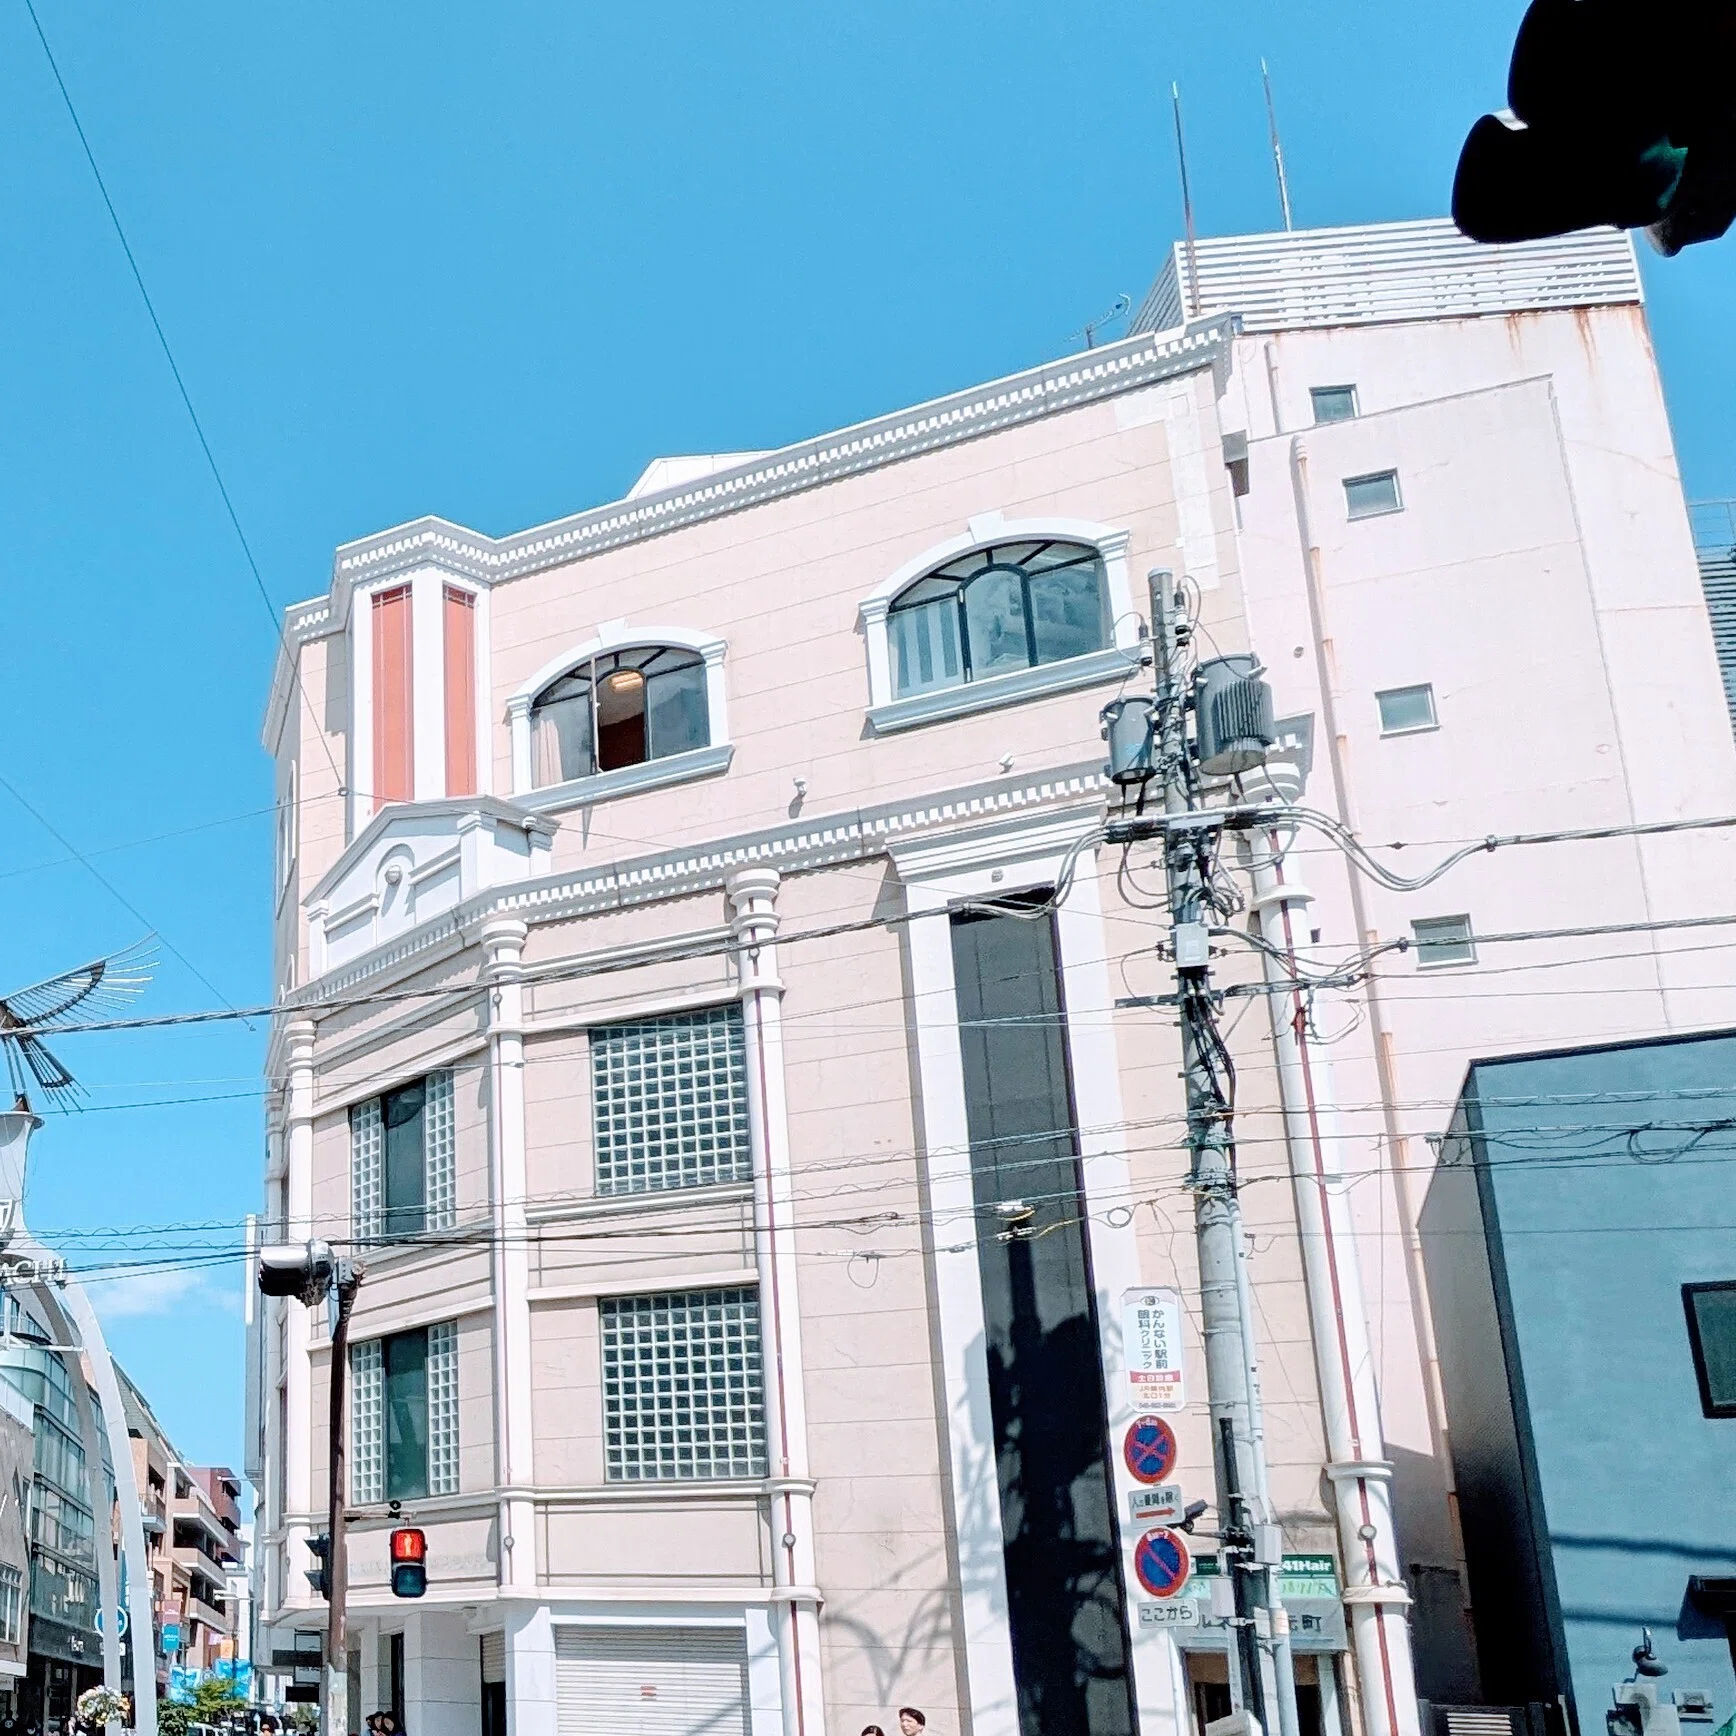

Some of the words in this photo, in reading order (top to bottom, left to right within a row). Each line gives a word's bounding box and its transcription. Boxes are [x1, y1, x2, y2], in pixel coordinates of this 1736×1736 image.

[1137, 1309, 1153, 1369] 眼科クリニック
[1152, 1309, 1168, 1369] かんない駅前
[1142, 1606, 1192, 1621] ここから
